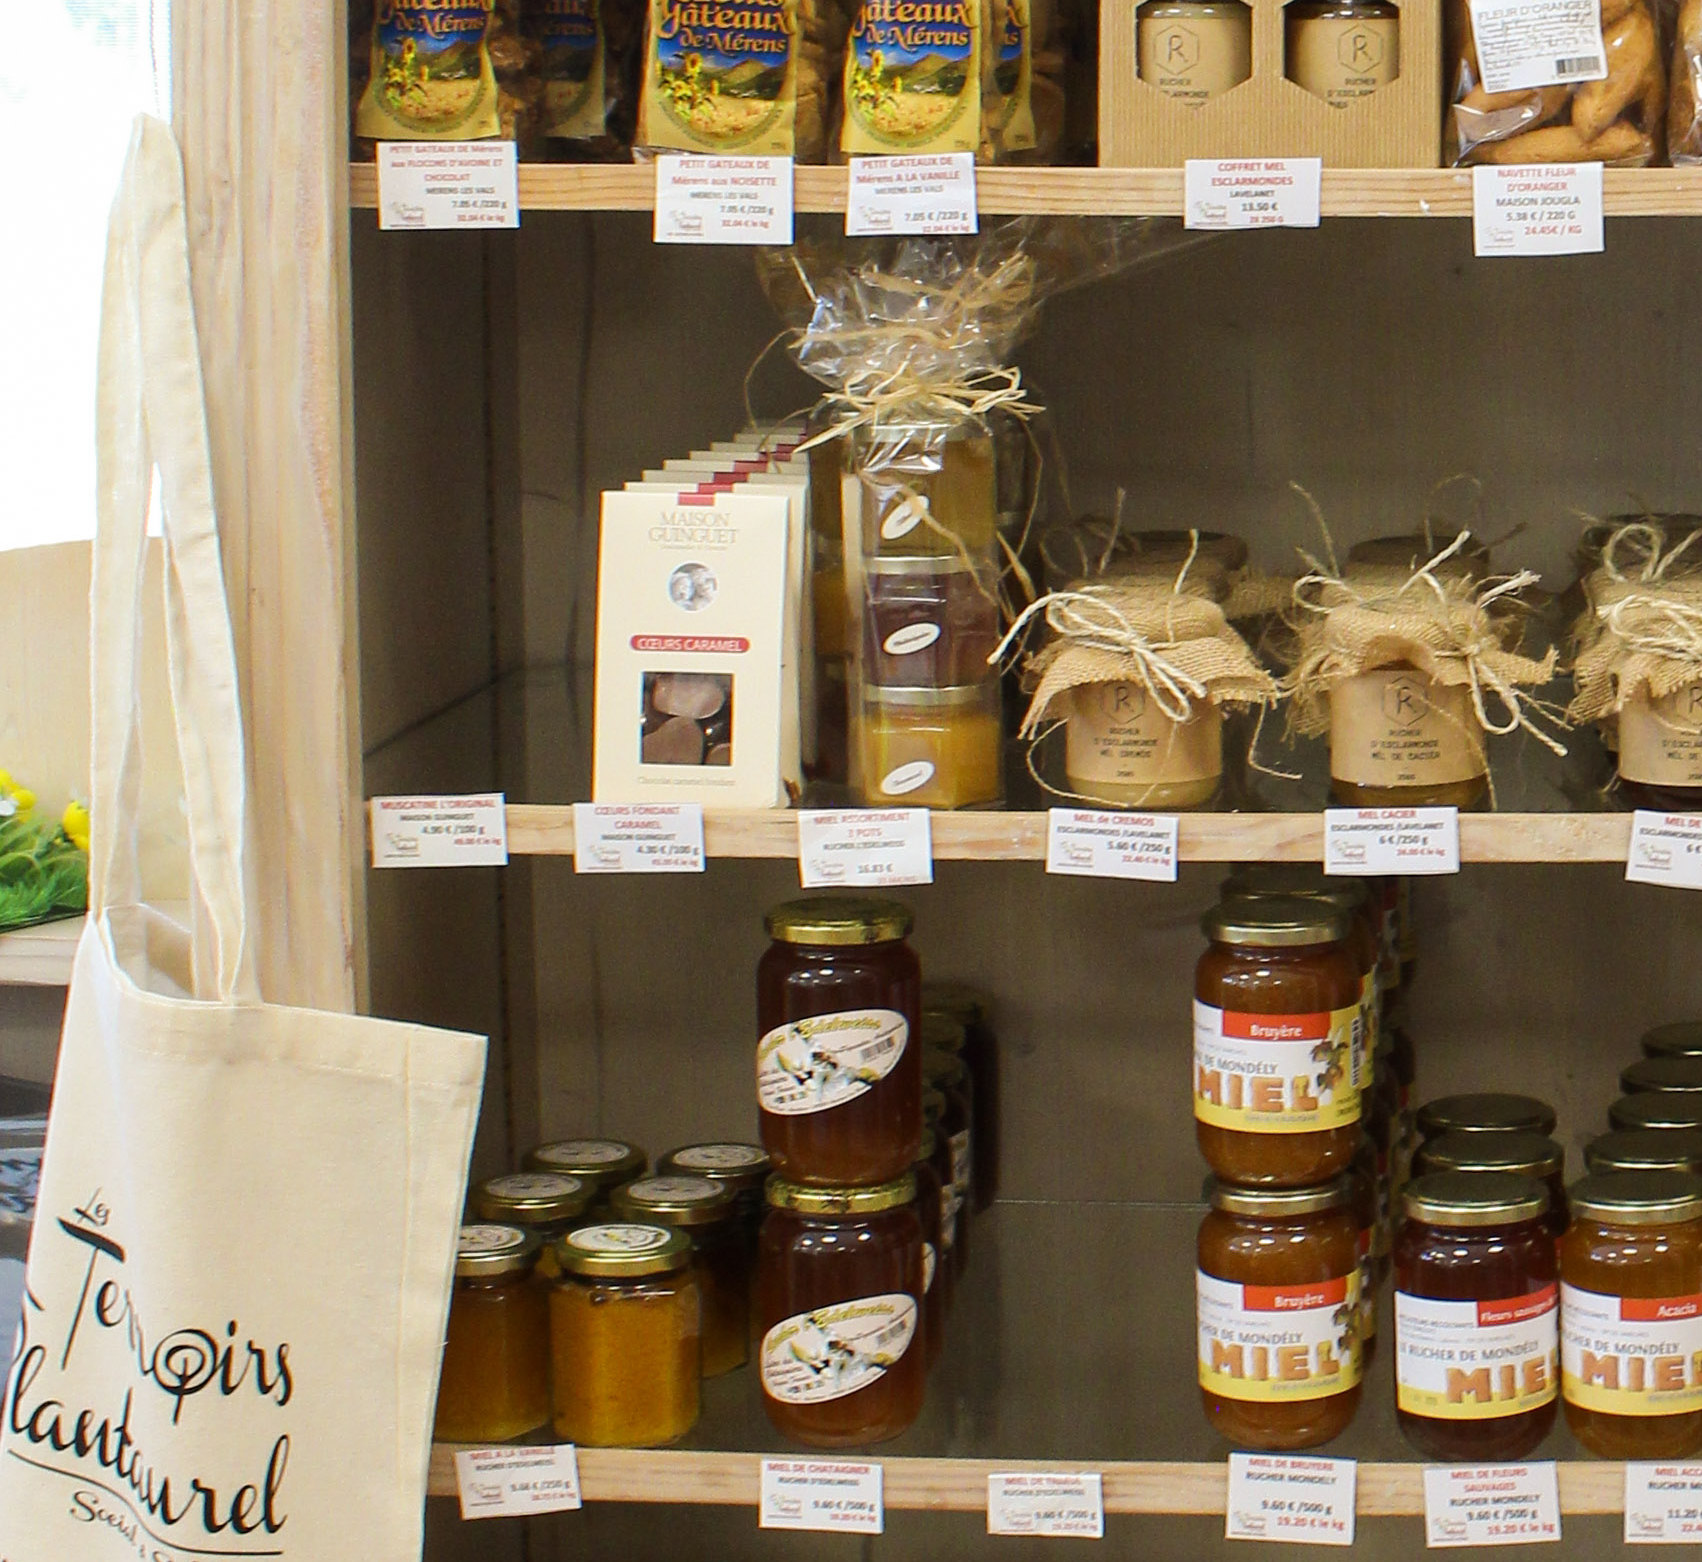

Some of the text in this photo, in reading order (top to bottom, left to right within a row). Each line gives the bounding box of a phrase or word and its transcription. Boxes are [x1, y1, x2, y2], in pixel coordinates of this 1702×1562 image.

[418, 11, 486, 39] Mérens
[704, 31, 787, 57] Mérens
[885, 25, 968, 54] Mérens
[661, 511, 730, 526] MAISON
[684, 639, 742, 651] CARAMEL
[1250, 1024, 1302, 1040] Bruyère
[1198, 1064, 1319, 1112] MIEL
[1274, 1293, 1325, 1309] Bruyère
[1656, 1303, 1698, 1318] Acacia
[1211, 1339, 1340, 1381] MIEL
[1460, 1348, 1477, 1362] DE
[9, 1290, 291, 1535] lantaurel
